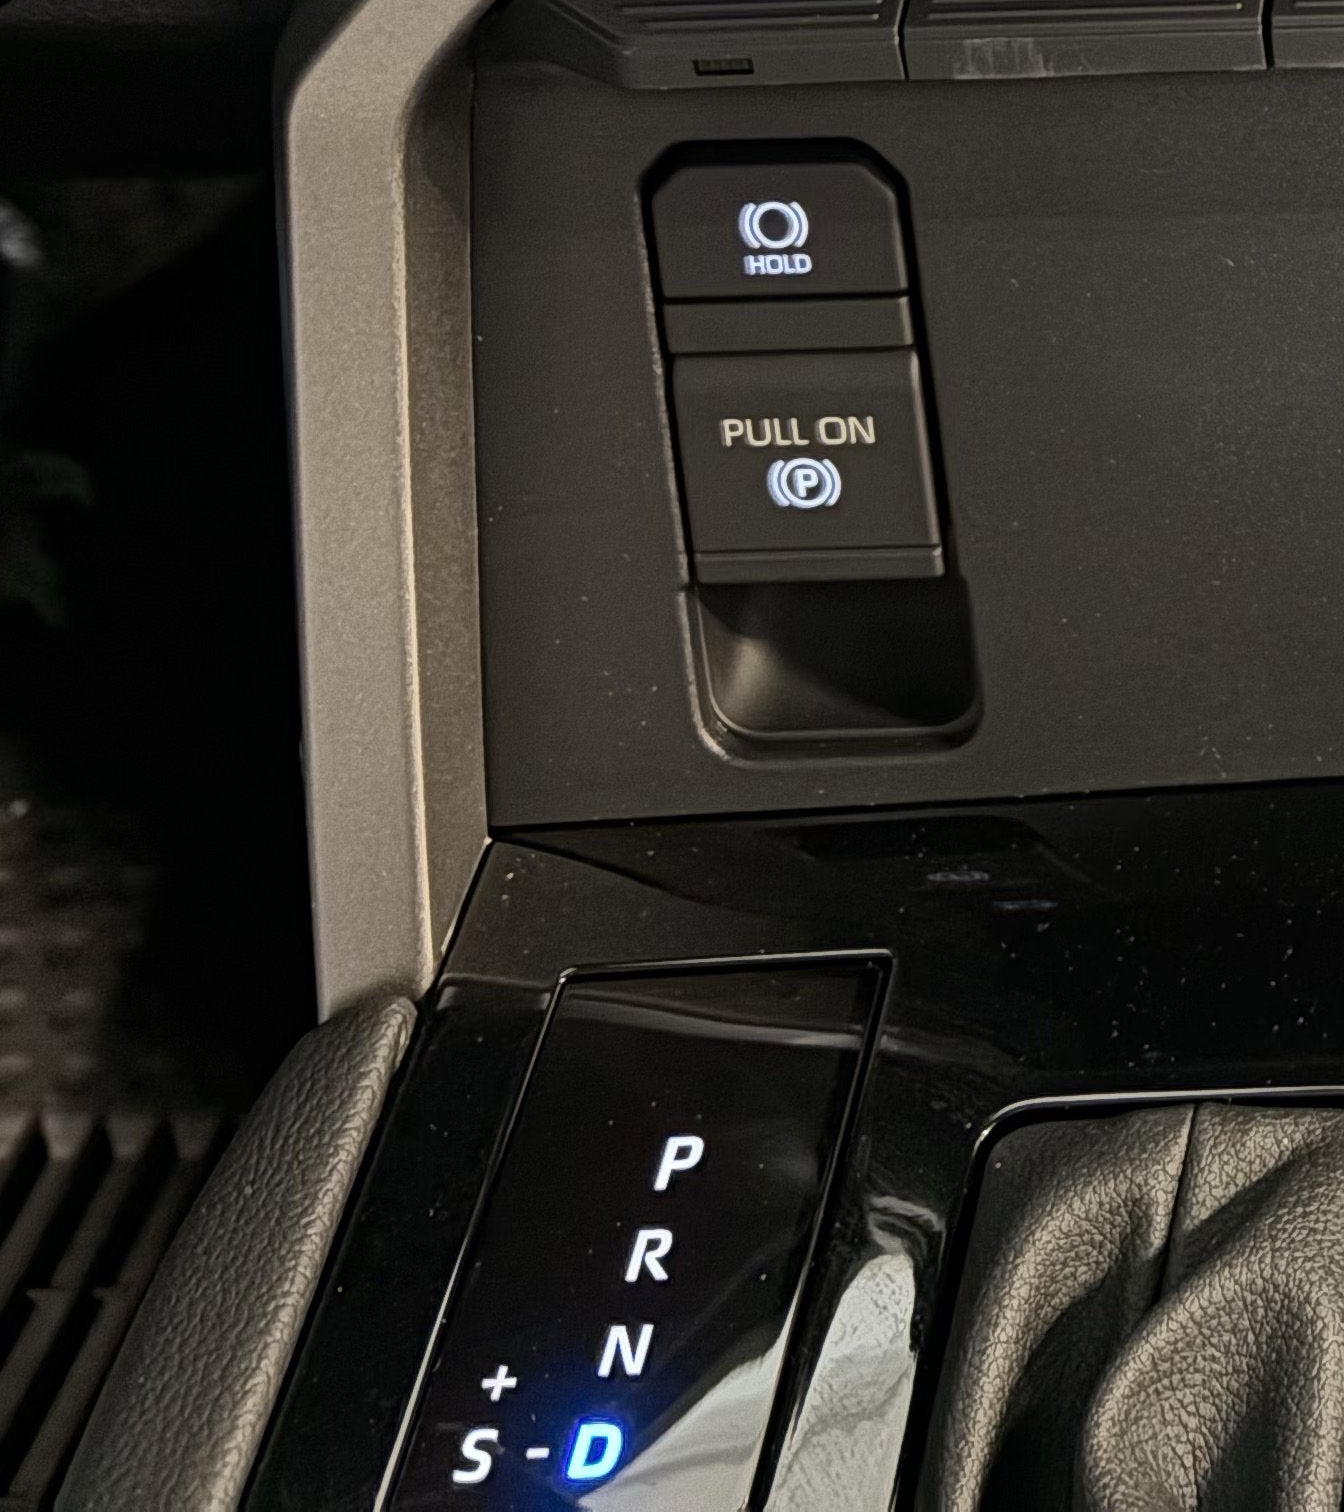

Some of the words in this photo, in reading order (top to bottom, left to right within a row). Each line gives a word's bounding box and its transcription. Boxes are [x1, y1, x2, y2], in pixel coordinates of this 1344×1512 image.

[744, 253, 813, 276] HOLD
[720, 417, 809, 447] PULL
[816, 416, 876, 445] ON
[653, 1136, 705, 1191] P
[624, 1229, 673, 1282] R
[598, 1324, 654, 1377] N
[452, 1428, 499, 1484] S
[566, 1422, 624, 1481] D
